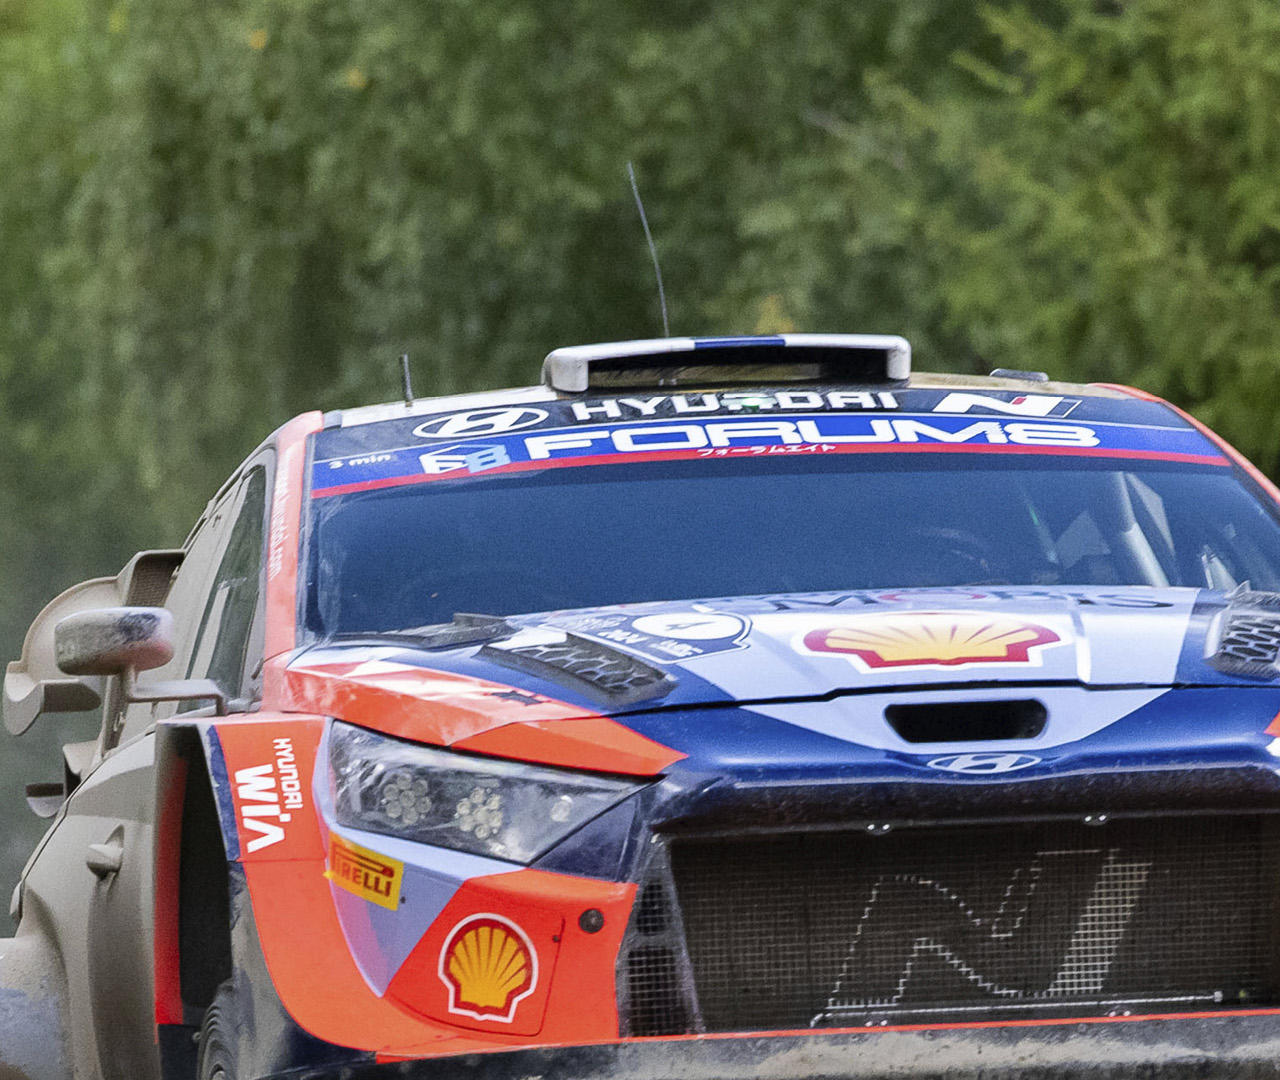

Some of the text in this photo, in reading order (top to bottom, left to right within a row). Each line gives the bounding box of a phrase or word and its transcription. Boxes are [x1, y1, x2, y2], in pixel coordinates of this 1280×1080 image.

[571, 391, 899, 421] HYUNDAI
[523, 419, 1101, 460] FORUM8
[696, 443, 837, 457] フォーラムエイト
[348, 454, 392, 467] min
[272, 737, 304, 809] HYUNDAI
[331, 841, 395, 898] PIRELLI
